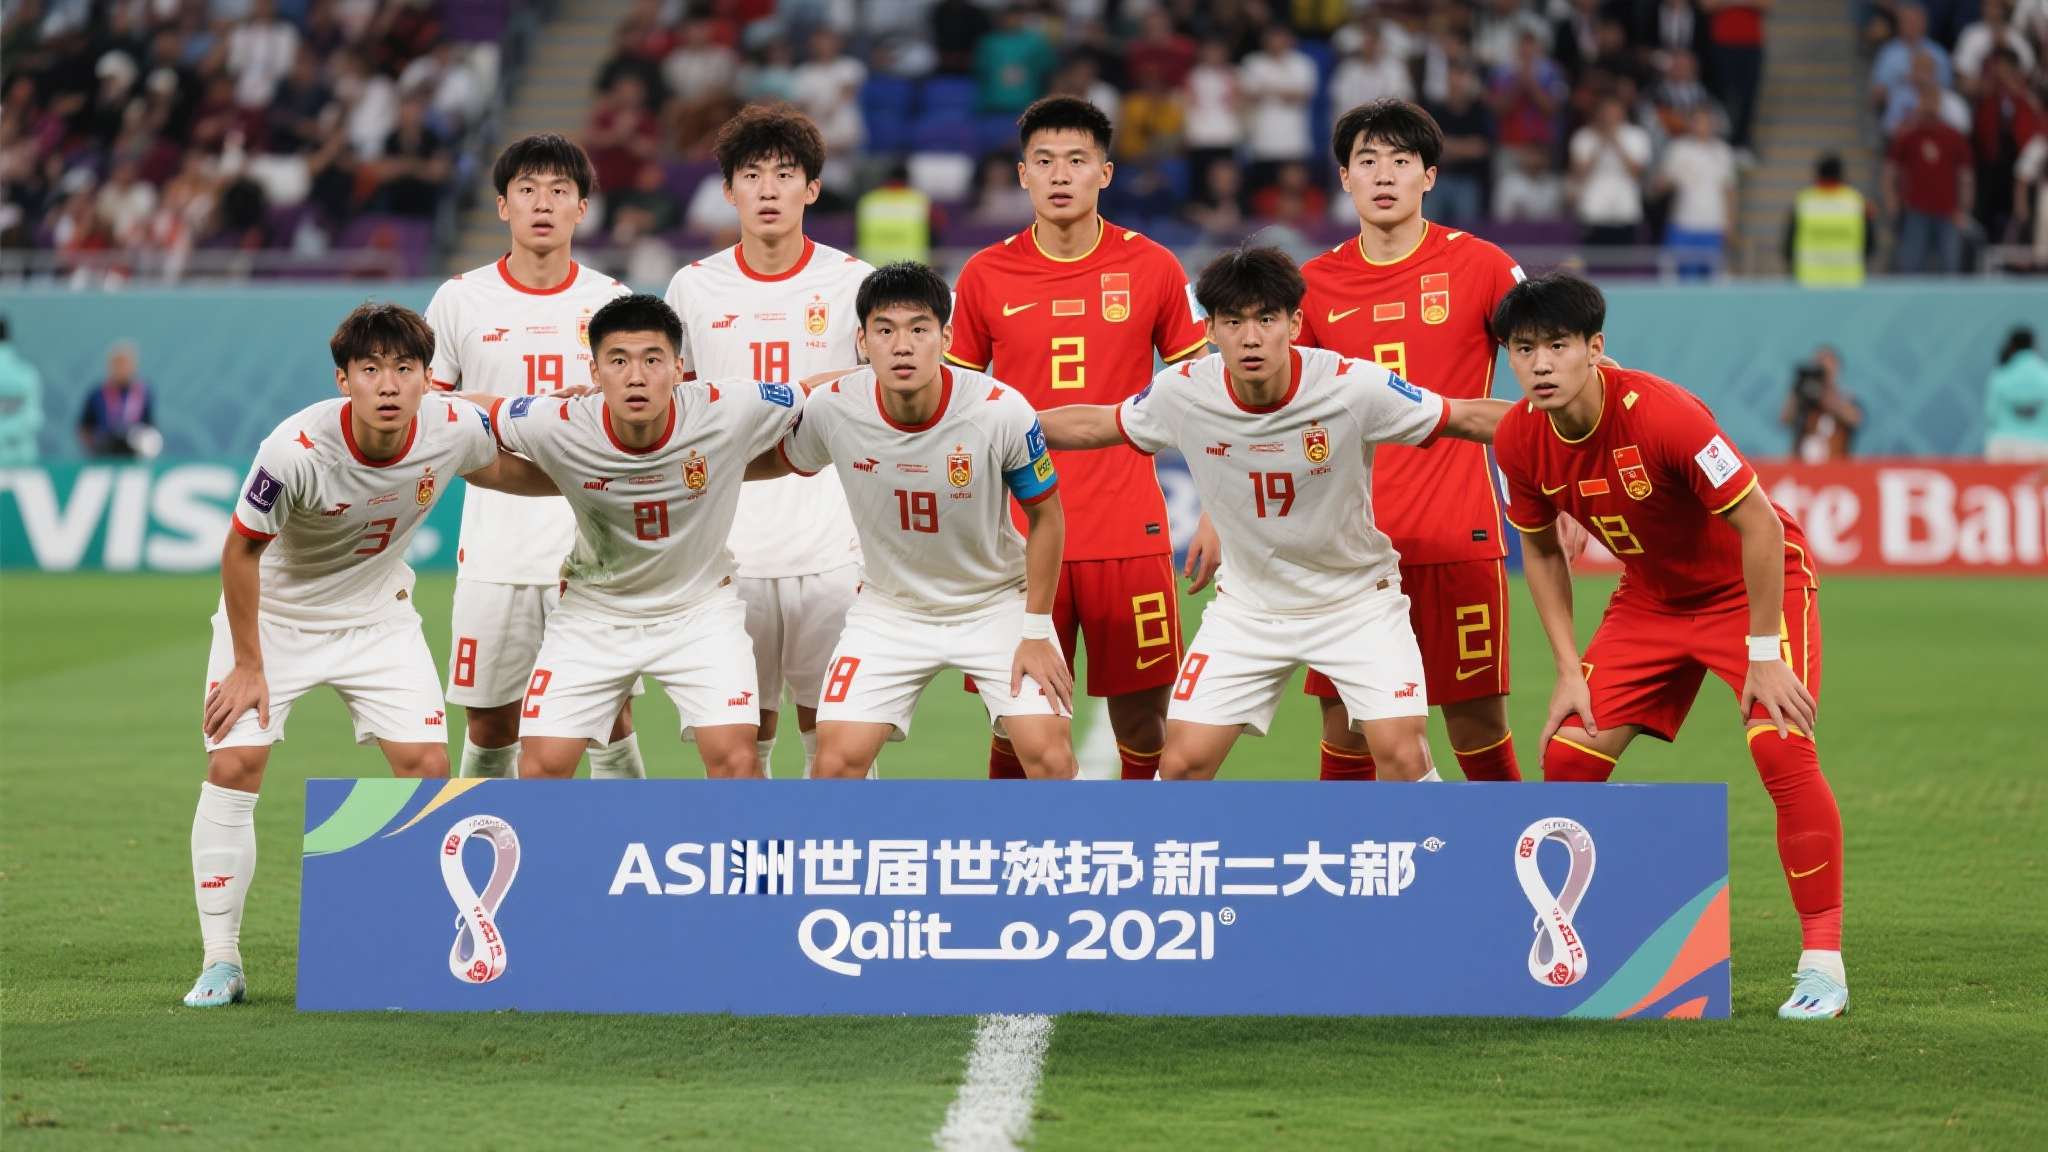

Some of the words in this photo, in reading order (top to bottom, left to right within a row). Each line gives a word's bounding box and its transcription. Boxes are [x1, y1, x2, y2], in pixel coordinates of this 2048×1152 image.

[522, 354, 563, 395] 19
[1051, 336, 1085, 389] 2
[894, 489, 940, 533] 19
[1248, 471, 1296, 518] 19
[1456, 603, 1492, 660] 2
[454, 637, 478, 687] 8
[1065, 909, 1216, 961] 2021
